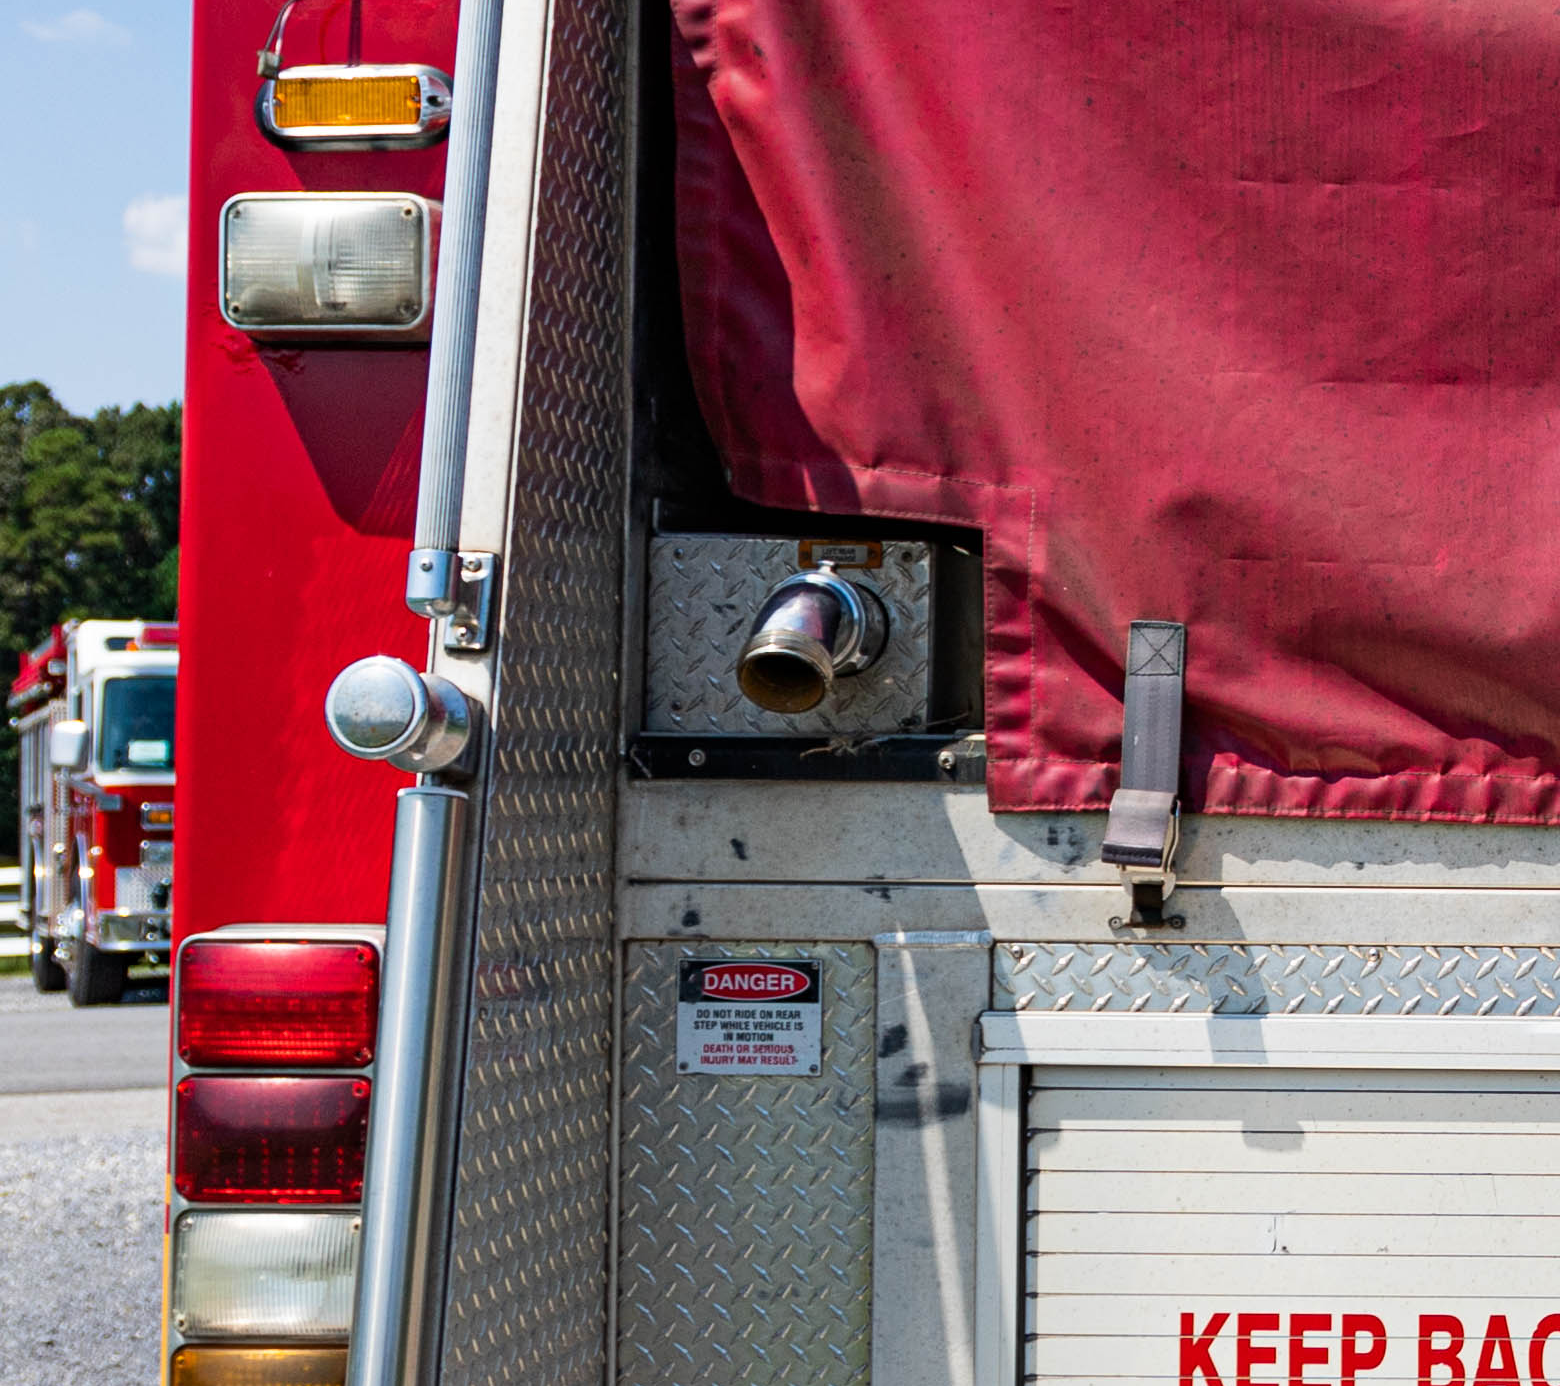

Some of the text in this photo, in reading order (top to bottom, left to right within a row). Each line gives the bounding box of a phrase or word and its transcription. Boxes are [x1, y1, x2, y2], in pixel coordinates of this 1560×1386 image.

[703, 973, 795, 991] DANGER
[696, 1009, 801, 1020] DO NOT RIDE ON REAR
[693, 1020, 804, 1031] STEP WHILE VEHICLE IS
[723, 1032, 774, 1042] IN MOTION
[703, 1044, 795, 1054] DEATH OR SERIOUS
[700, 1055, 735, 1065] INJURY
[737, 1055, 758, 1065] MAY
